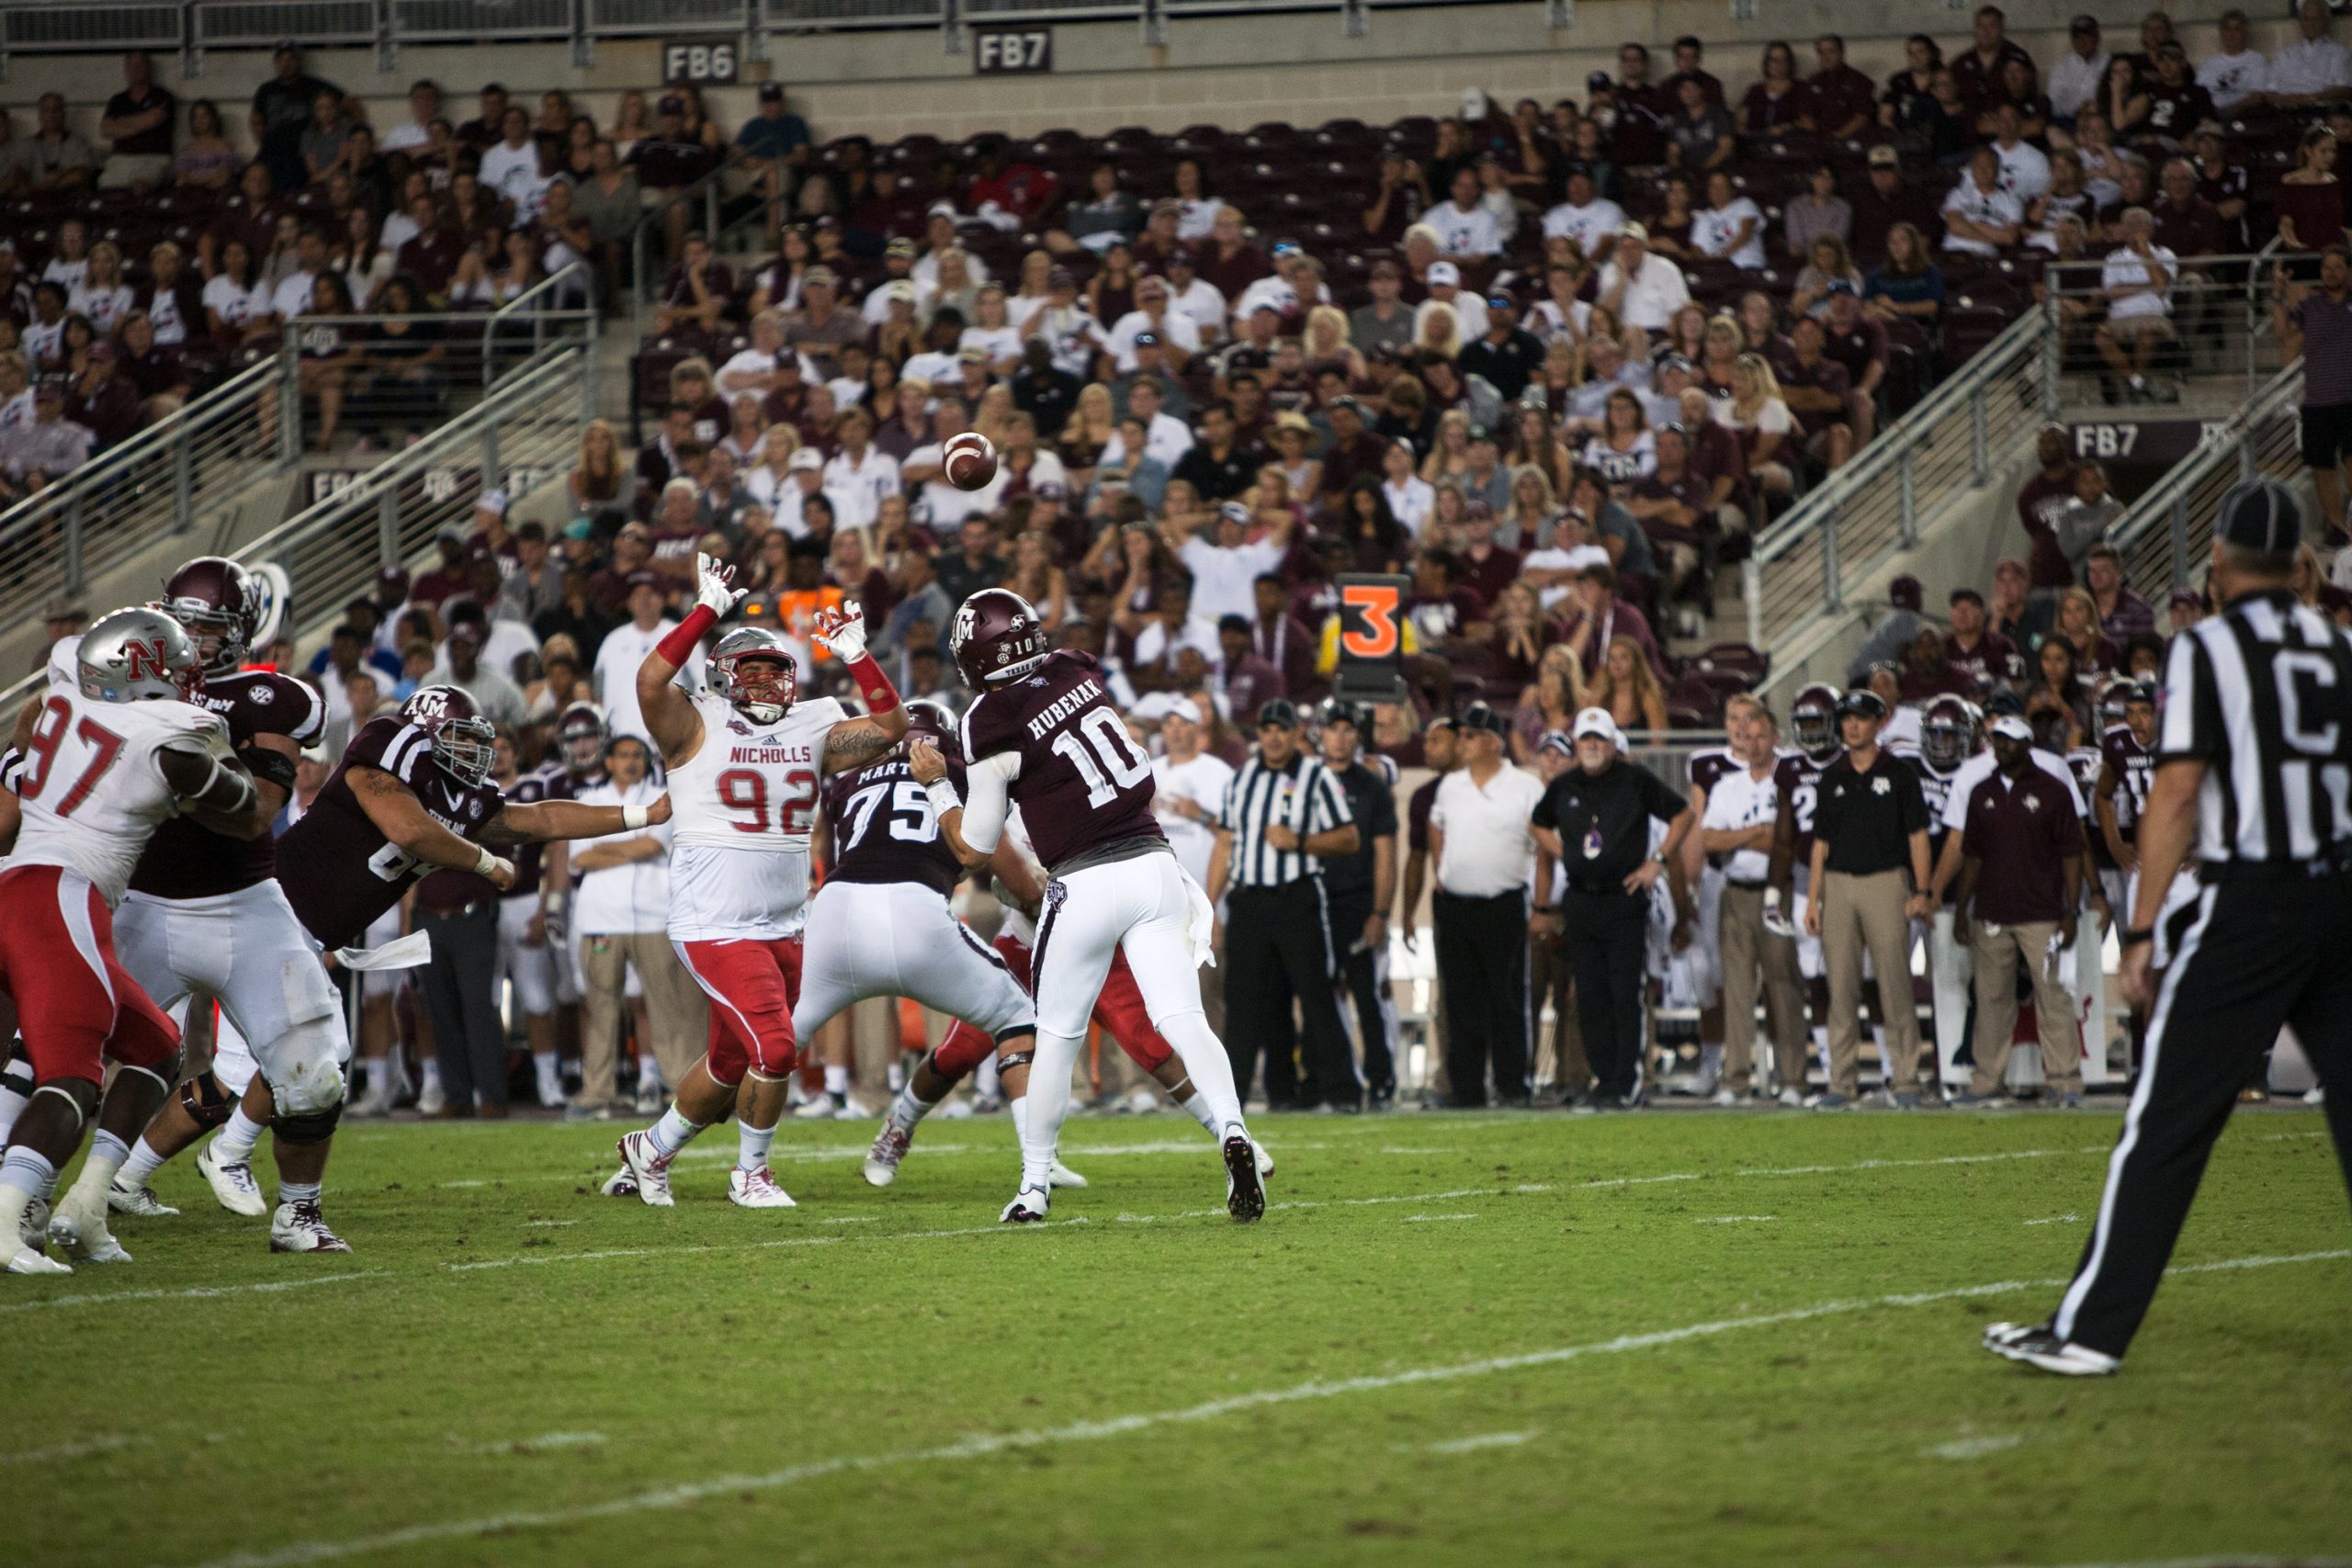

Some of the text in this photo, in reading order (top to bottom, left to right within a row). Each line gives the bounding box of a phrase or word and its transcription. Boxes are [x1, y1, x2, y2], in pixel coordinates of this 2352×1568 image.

[666, 44, 734, 81] FB6
[978, 32, 1048, 69] FB7
[2150, 98, 2177, 128] 2
[2075, 423, 2139, 457] FB7
[1342, 585, 1399, 658] 3
[123, 637, 166, 682] N
[1015, 637, 1034, 655] 10
[1005, 664, 1030, 677] TEXAS
[1027, 678, 1102, 740] HUBENAK
[2272, 649, 2340, 756] C
[20, 694, 128, 818] 97
[729, 745, 811, 764] NICHOLLS
[1051, 705, 1151, 810] 10
[715, 768, 820, 836] 92
[843, 781, 938, 852] 75
